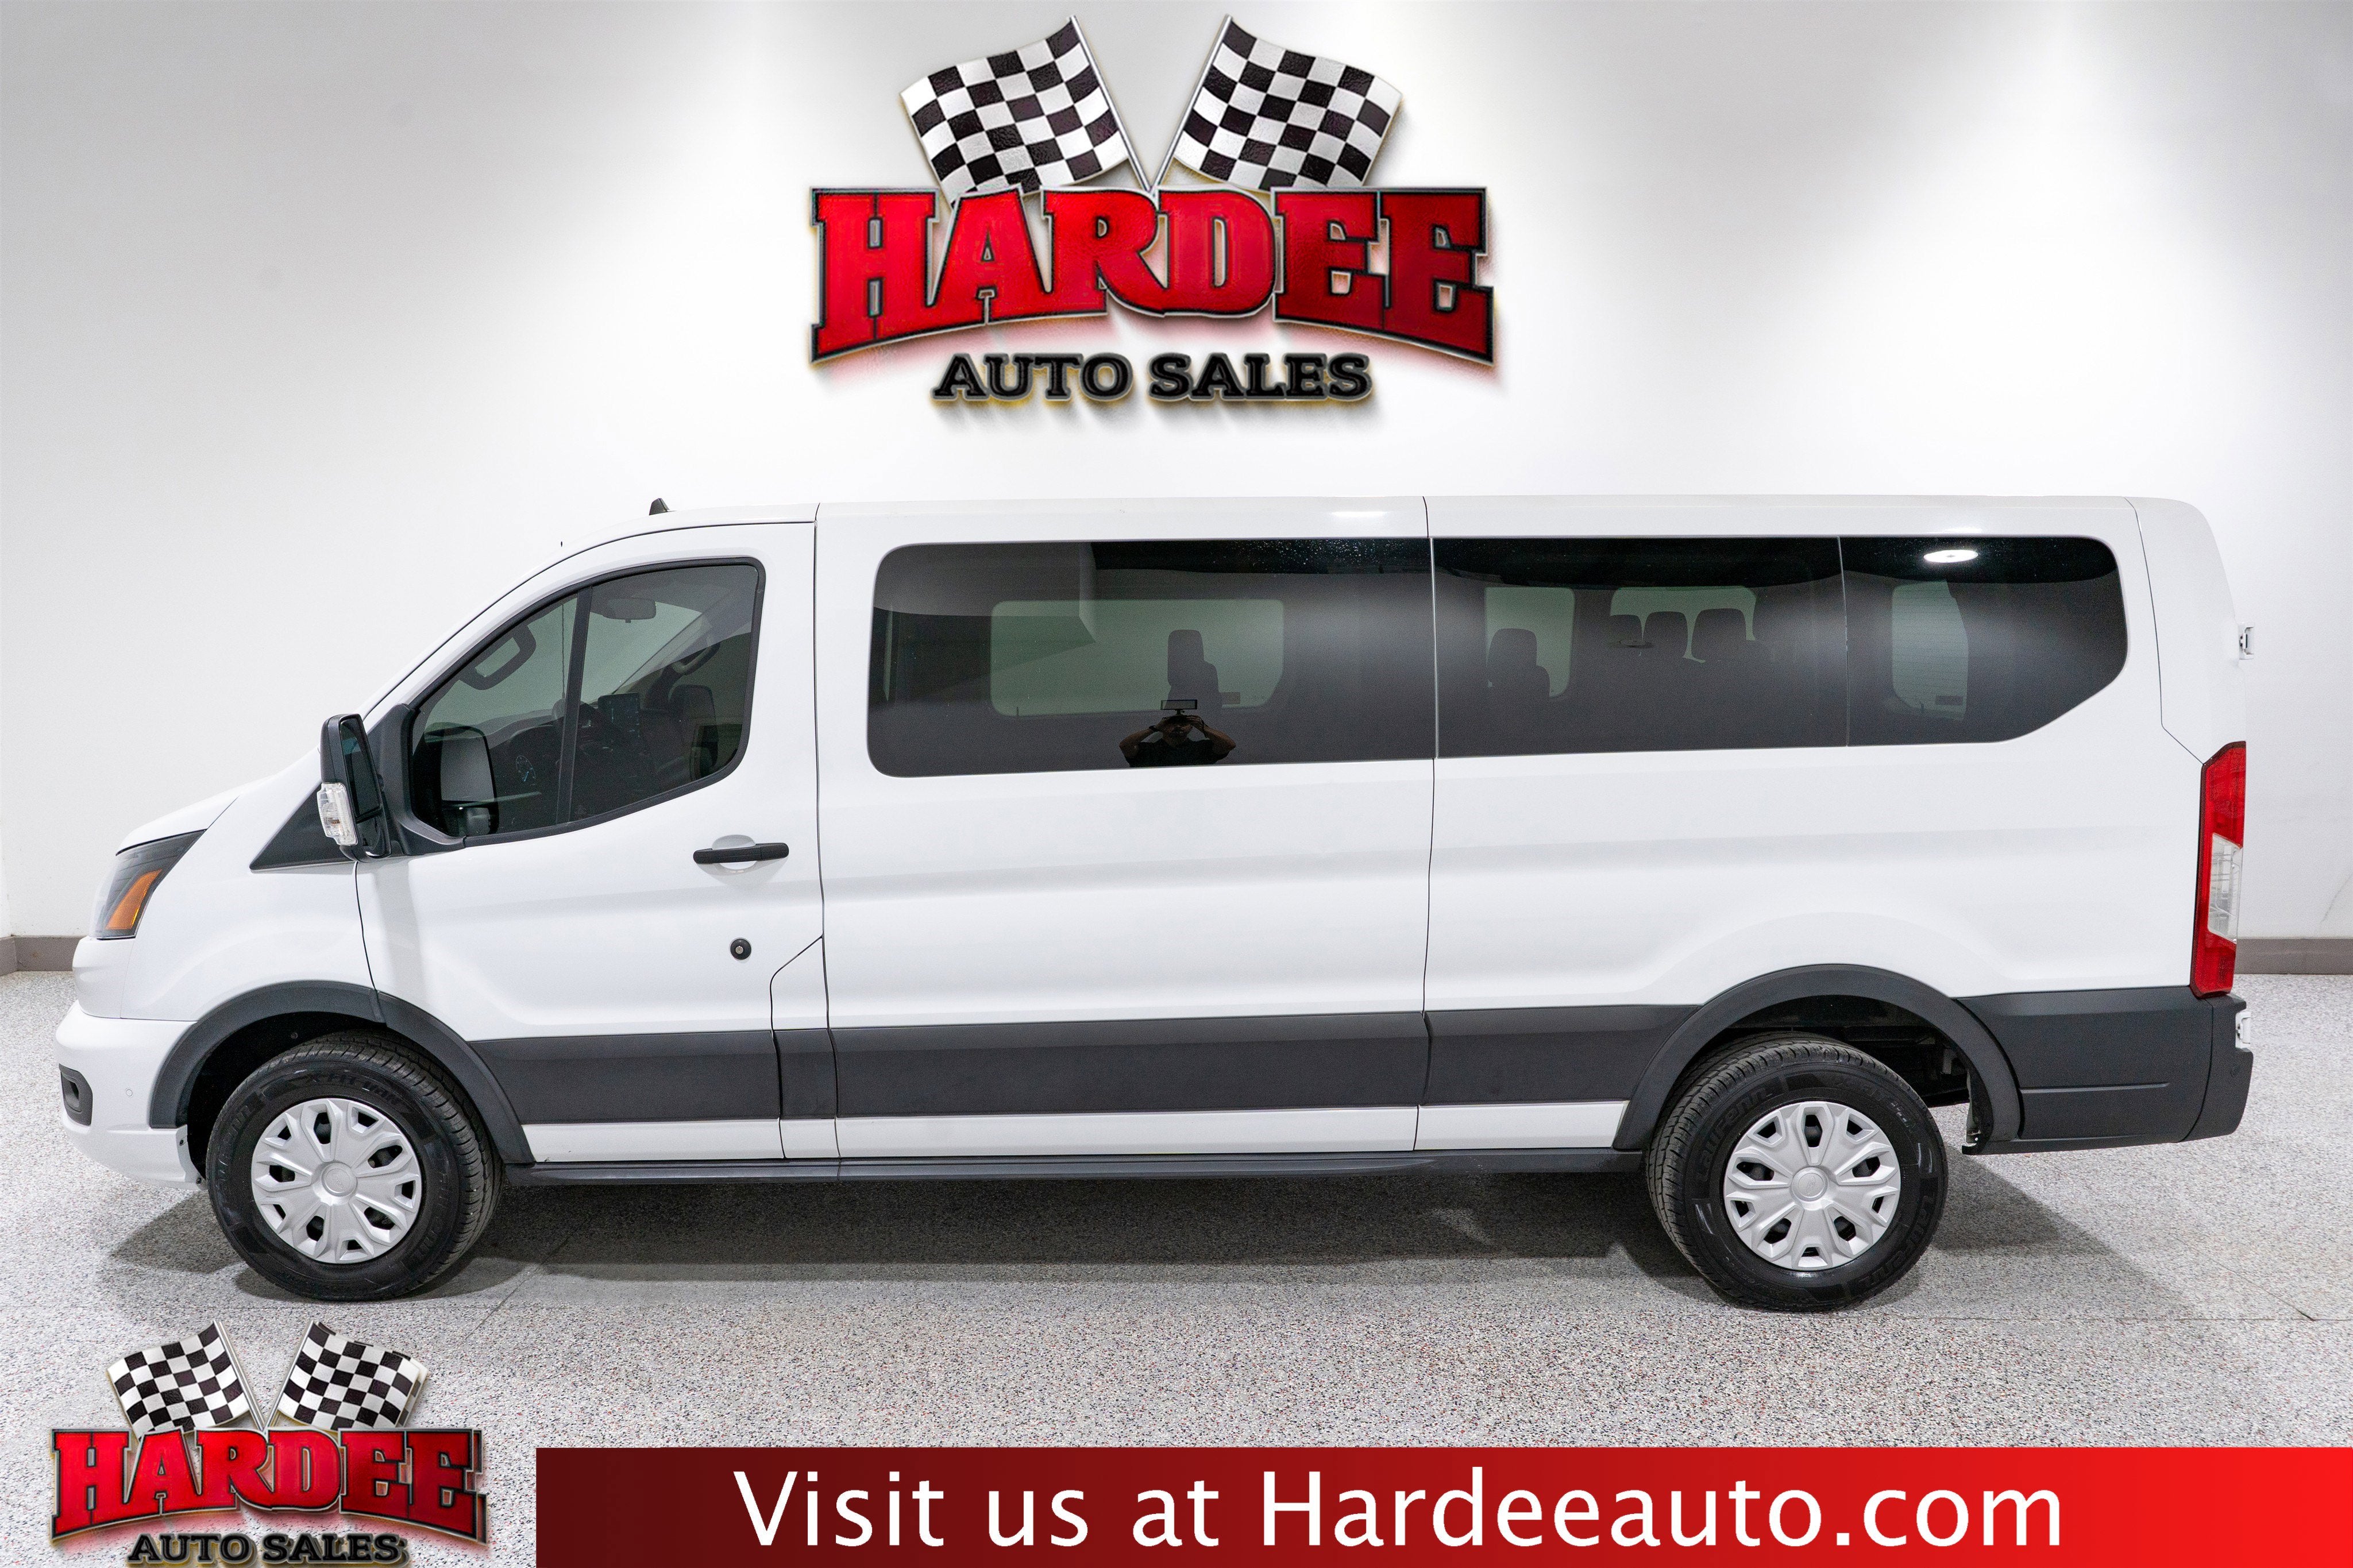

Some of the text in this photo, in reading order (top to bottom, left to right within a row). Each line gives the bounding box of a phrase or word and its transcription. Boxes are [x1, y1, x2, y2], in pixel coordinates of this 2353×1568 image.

[810, 187, 1495, 363] HARDEE
[932, 352, 1372, 401] AUTO SALES
